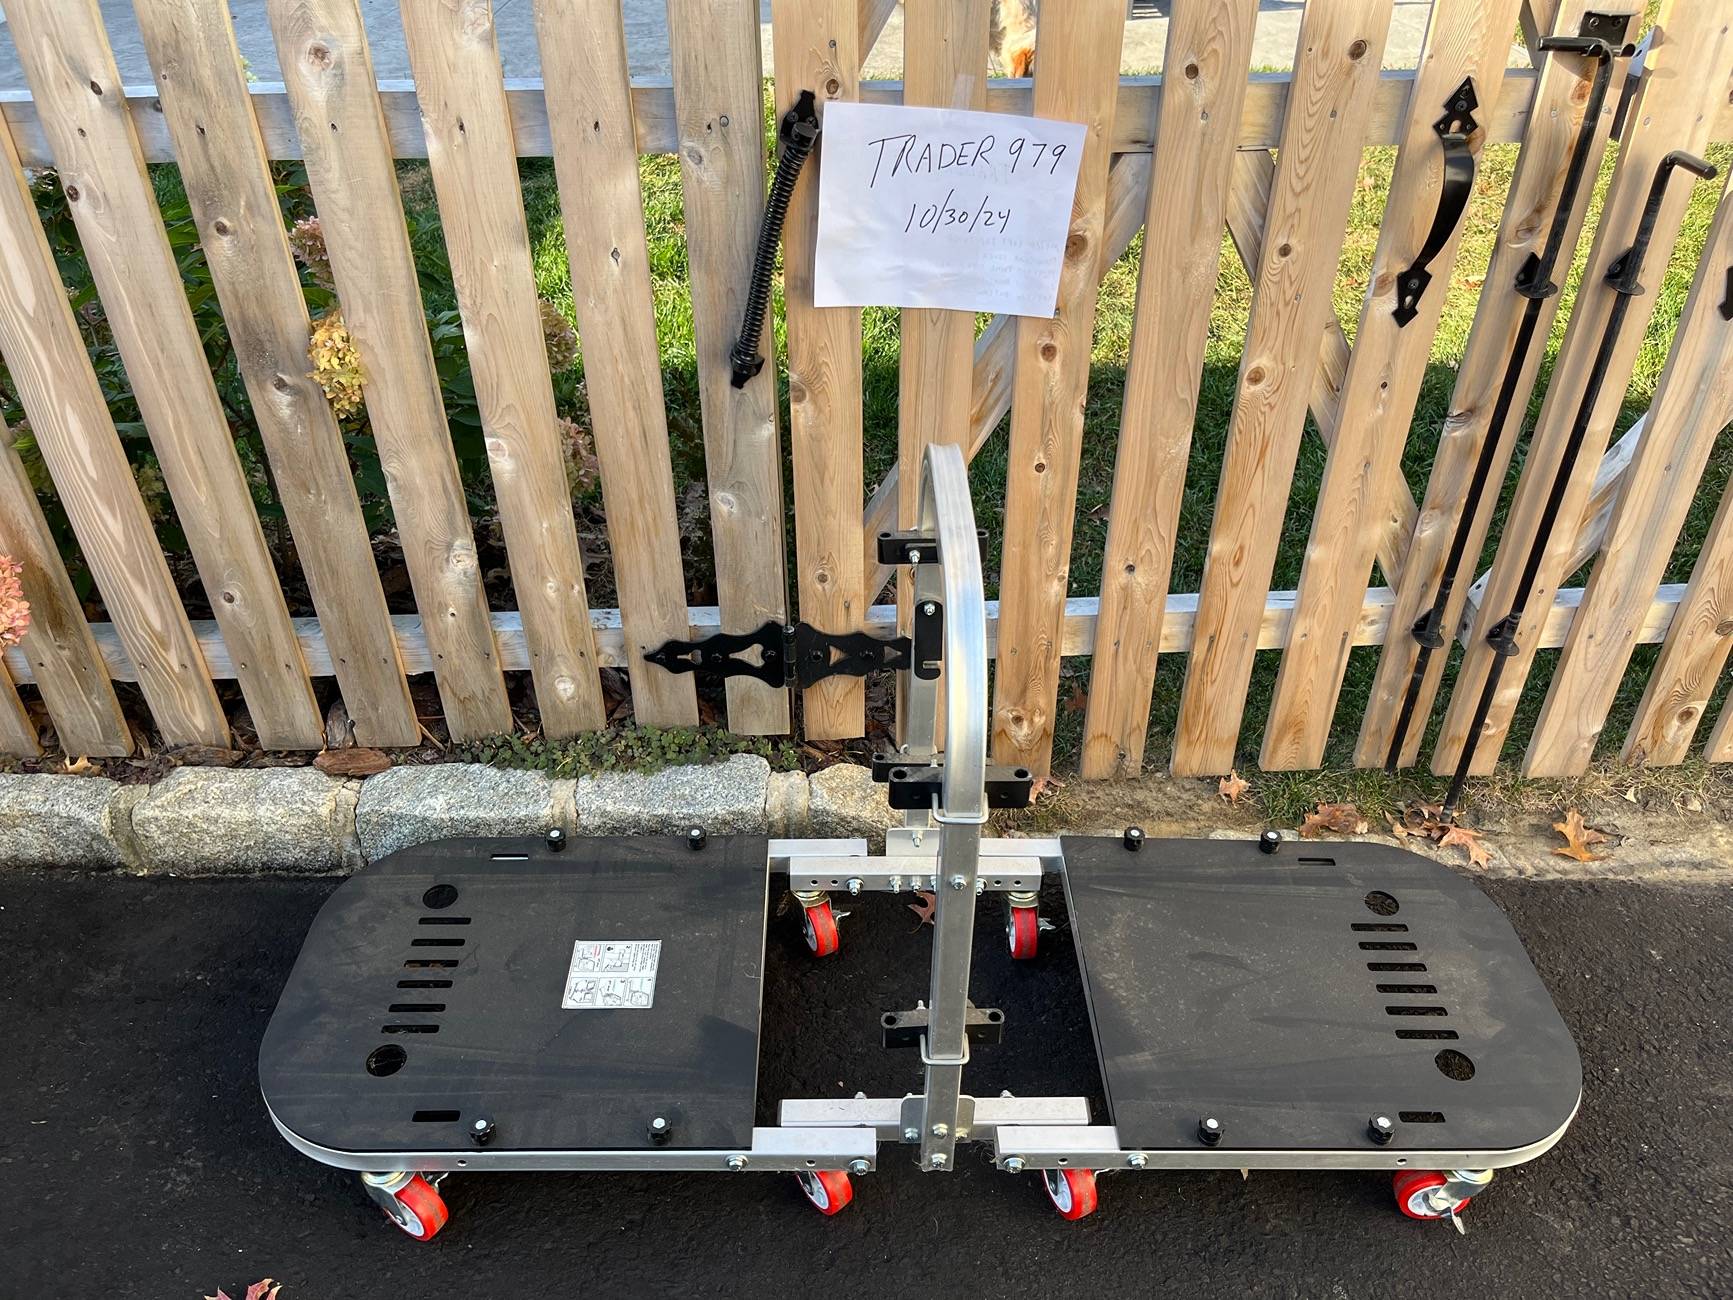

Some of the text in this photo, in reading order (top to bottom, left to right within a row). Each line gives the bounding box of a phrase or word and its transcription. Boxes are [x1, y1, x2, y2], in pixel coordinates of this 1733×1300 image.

[868, 134, 995, 188] TRADER
[1008, 137, 1067, 174] 979
[904, 188, 1011, 234] 10/30/24
